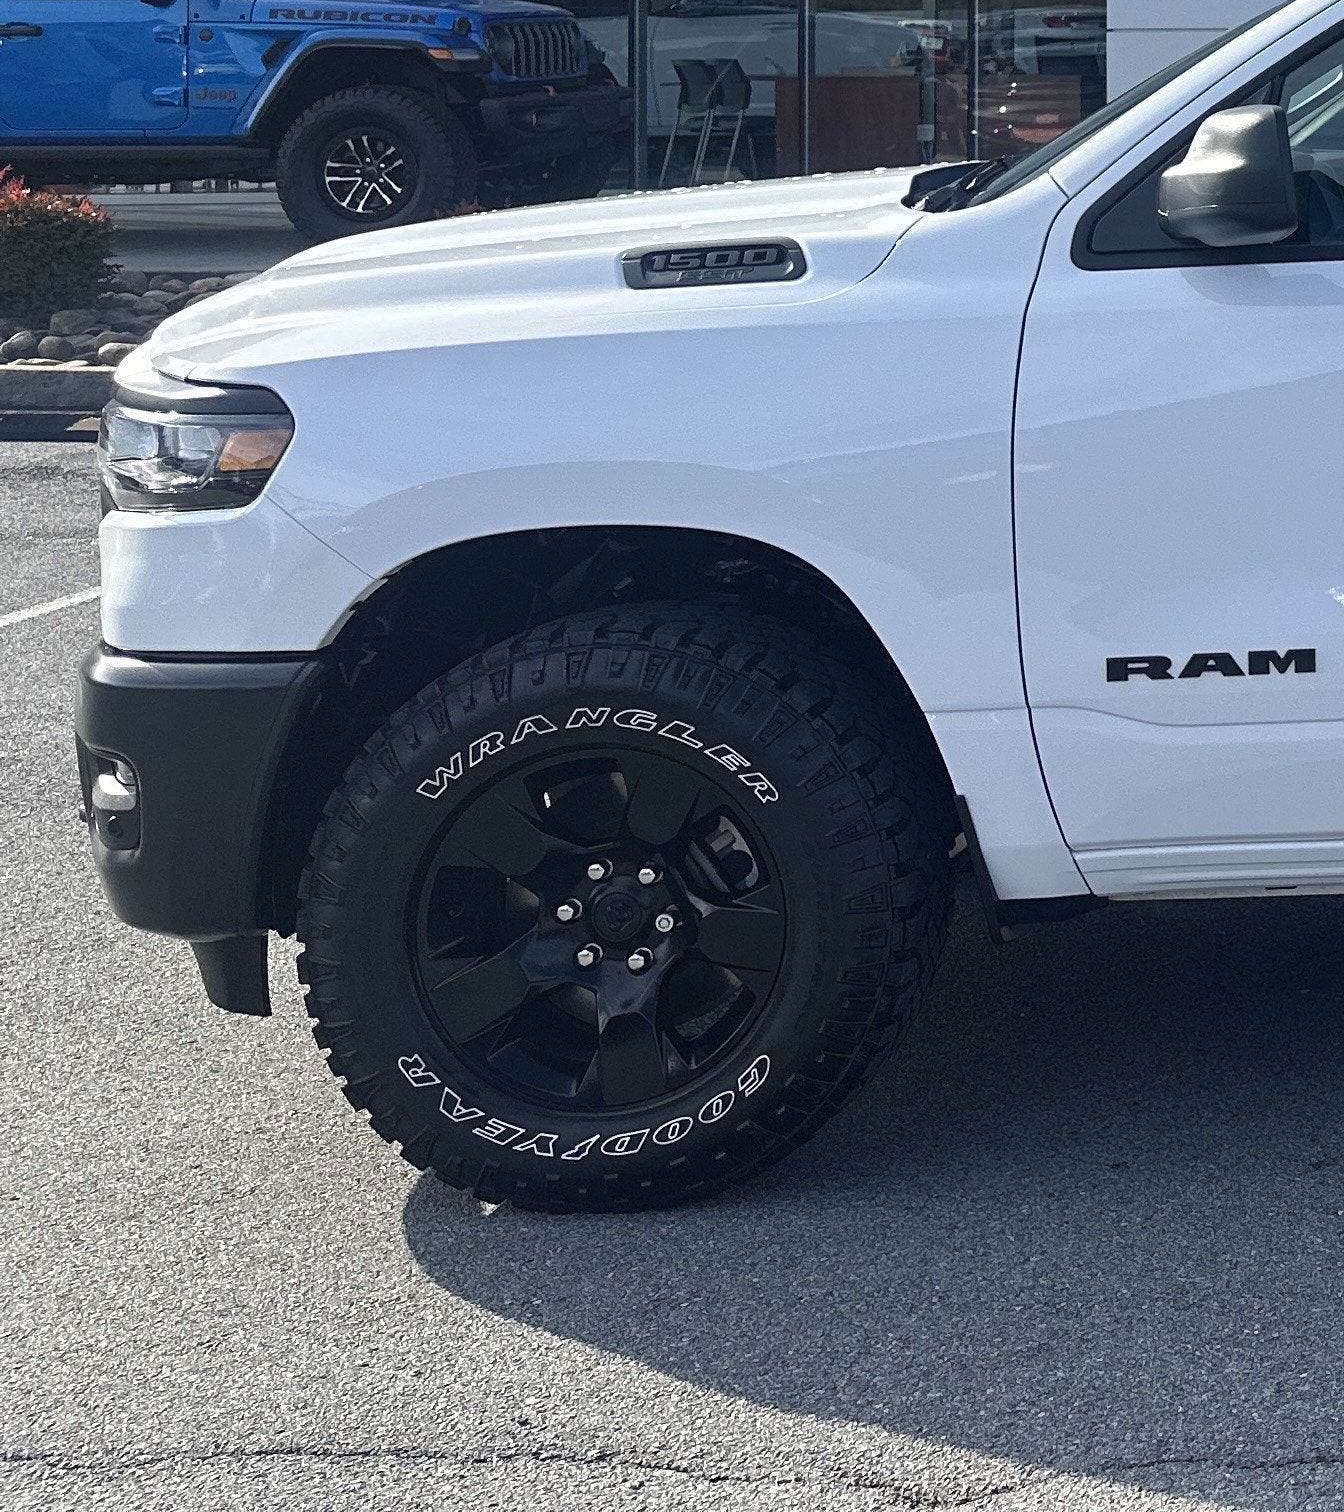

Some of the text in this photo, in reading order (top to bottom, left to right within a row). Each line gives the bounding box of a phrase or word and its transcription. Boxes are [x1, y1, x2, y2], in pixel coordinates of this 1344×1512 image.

[268, 8, 438, 25] RUBICON
[651, 248, 779, 271] 1500
[1106, 648, 1316, 682] RAM
[416, 707, 779, 803] WRANGLER
[397, 1053, 770, 1160] GOODYEAR
